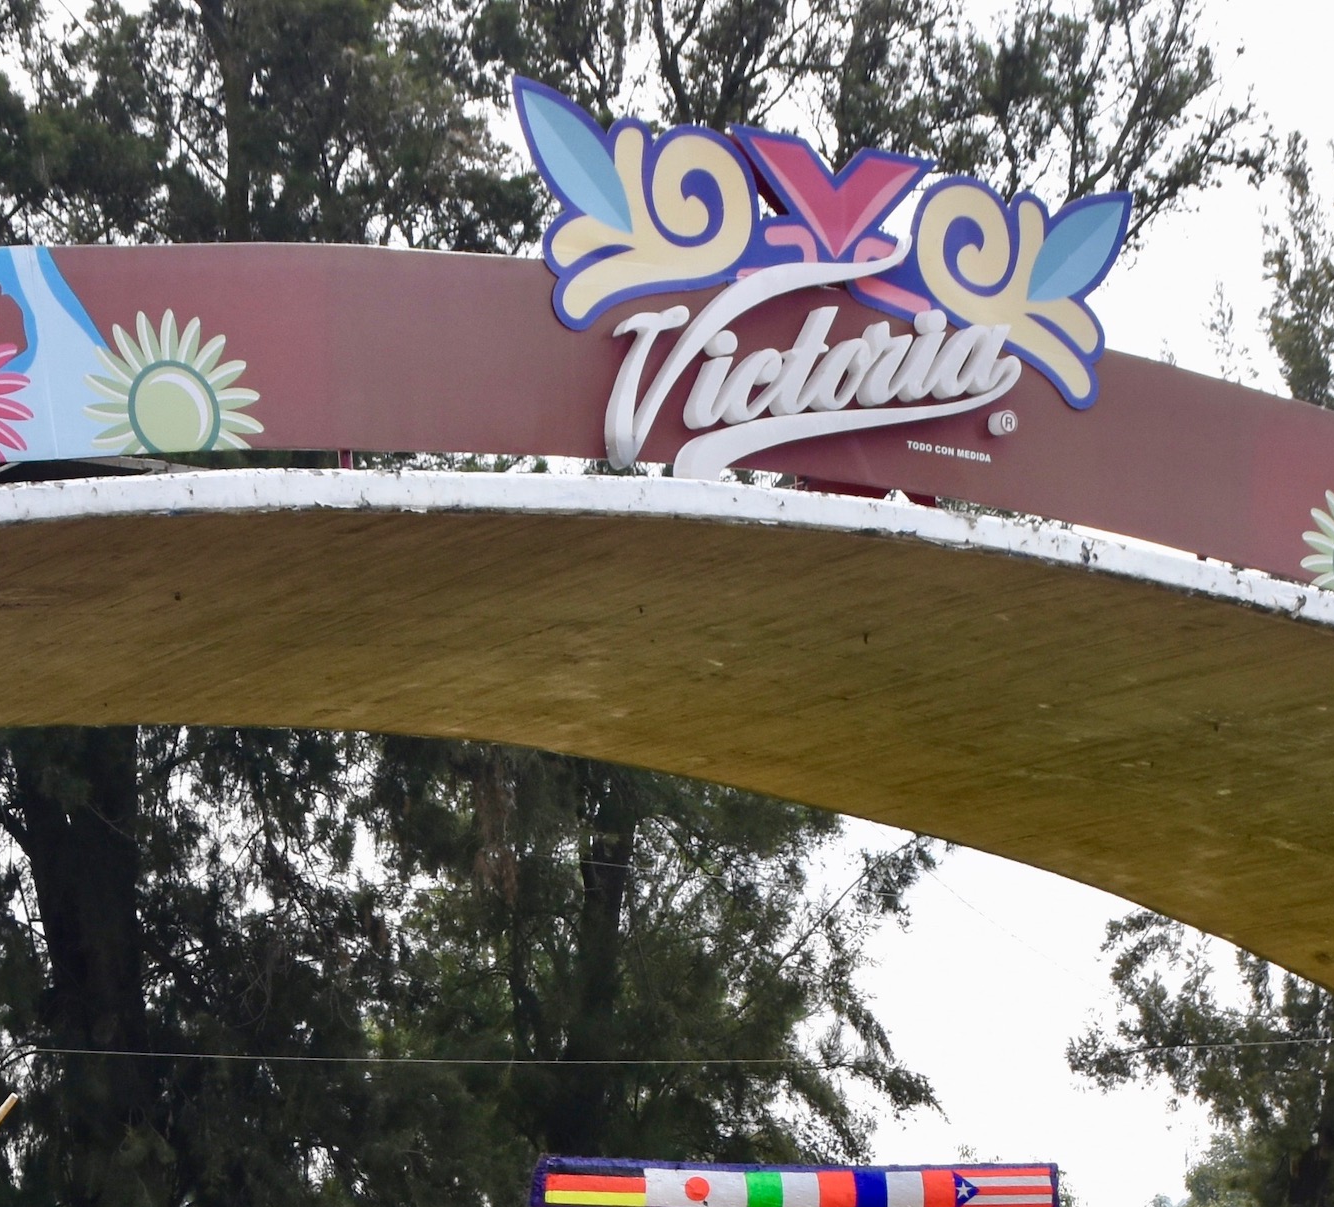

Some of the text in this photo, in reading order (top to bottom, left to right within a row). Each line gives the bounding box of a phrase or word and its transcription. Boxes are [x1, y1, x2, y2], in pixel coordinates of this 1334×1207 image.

[605, 235, 1022, 482] Victoria
[907, 440, 991, 463] TODO CON MEDIDA
